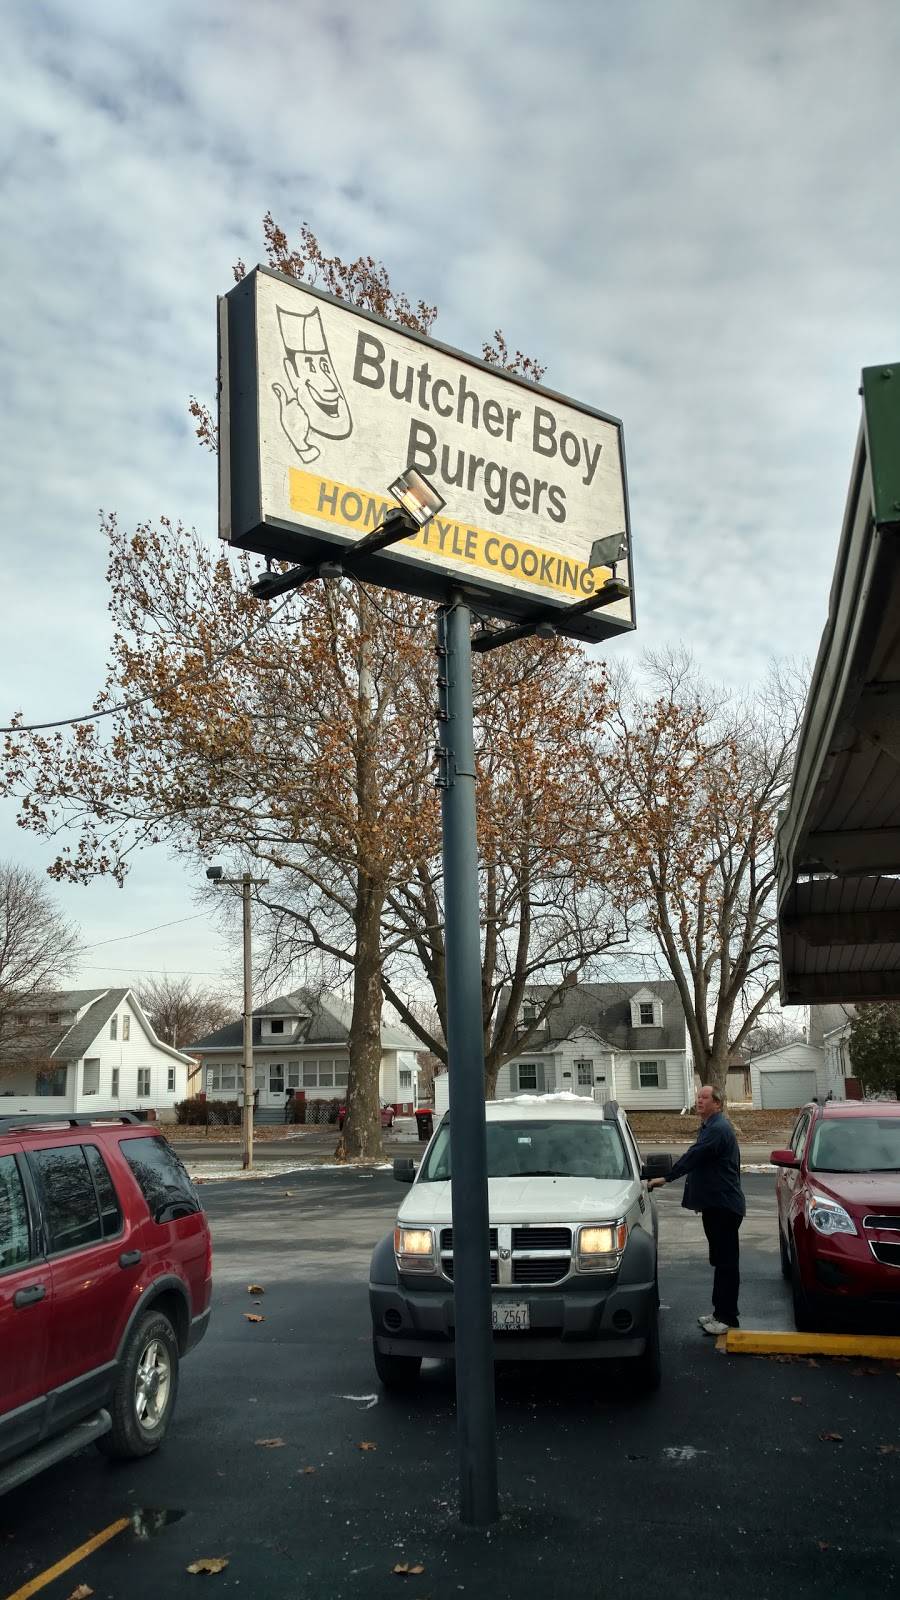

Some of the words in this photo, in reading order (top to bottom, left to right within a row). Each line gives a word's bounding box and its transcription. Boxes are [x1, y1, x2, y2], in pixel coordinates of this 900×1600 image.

[353, 330, 521, 442] Butcher
[532, 406, 602, 485] Boy
[406, 418, 567, 523] Burgers
[484, 538, 596, 594] COOKING
[504, 1310, 527, 1324] 2567
